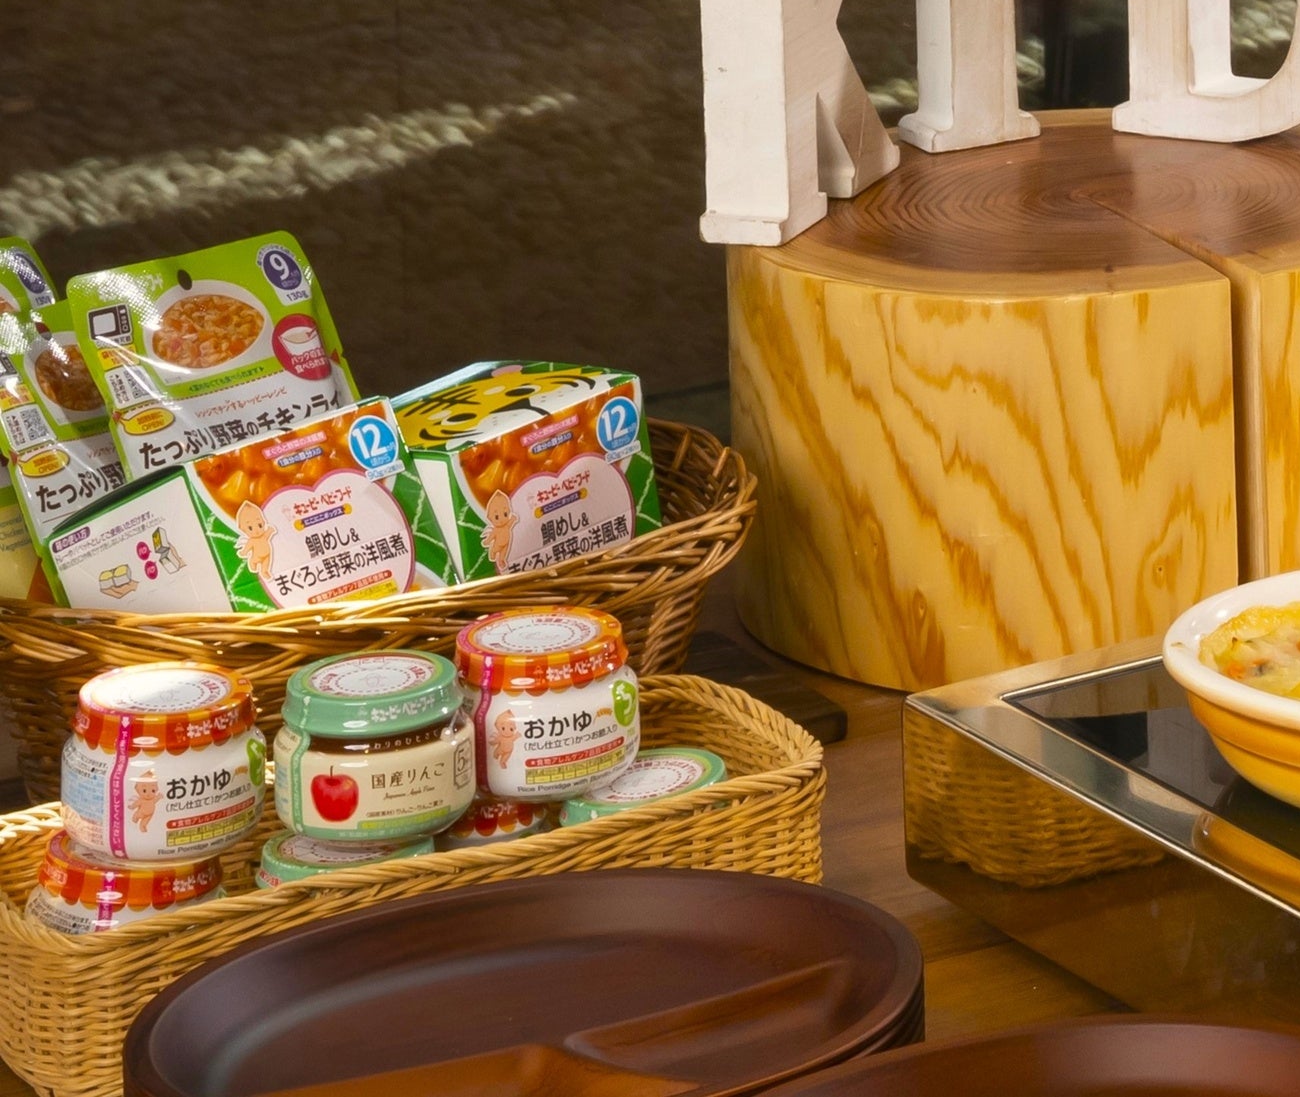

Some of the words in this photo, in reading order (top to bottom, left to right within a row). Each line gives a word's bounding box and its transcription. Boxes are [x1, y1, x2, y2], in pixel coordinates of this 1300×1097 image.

[270, 254, 290, 281] 9
[305, 527, 360, 559] 鯛めし&
[540, 511, 589, 546] 鯛めし&
[274, 533, 409, 596] まぐろと野菜の洋風煮
[524, 710, 592, 739] おかゆ
[166, 769, 231, 800] おかゆ
[371, 762, 445, 789] 国産りんご
